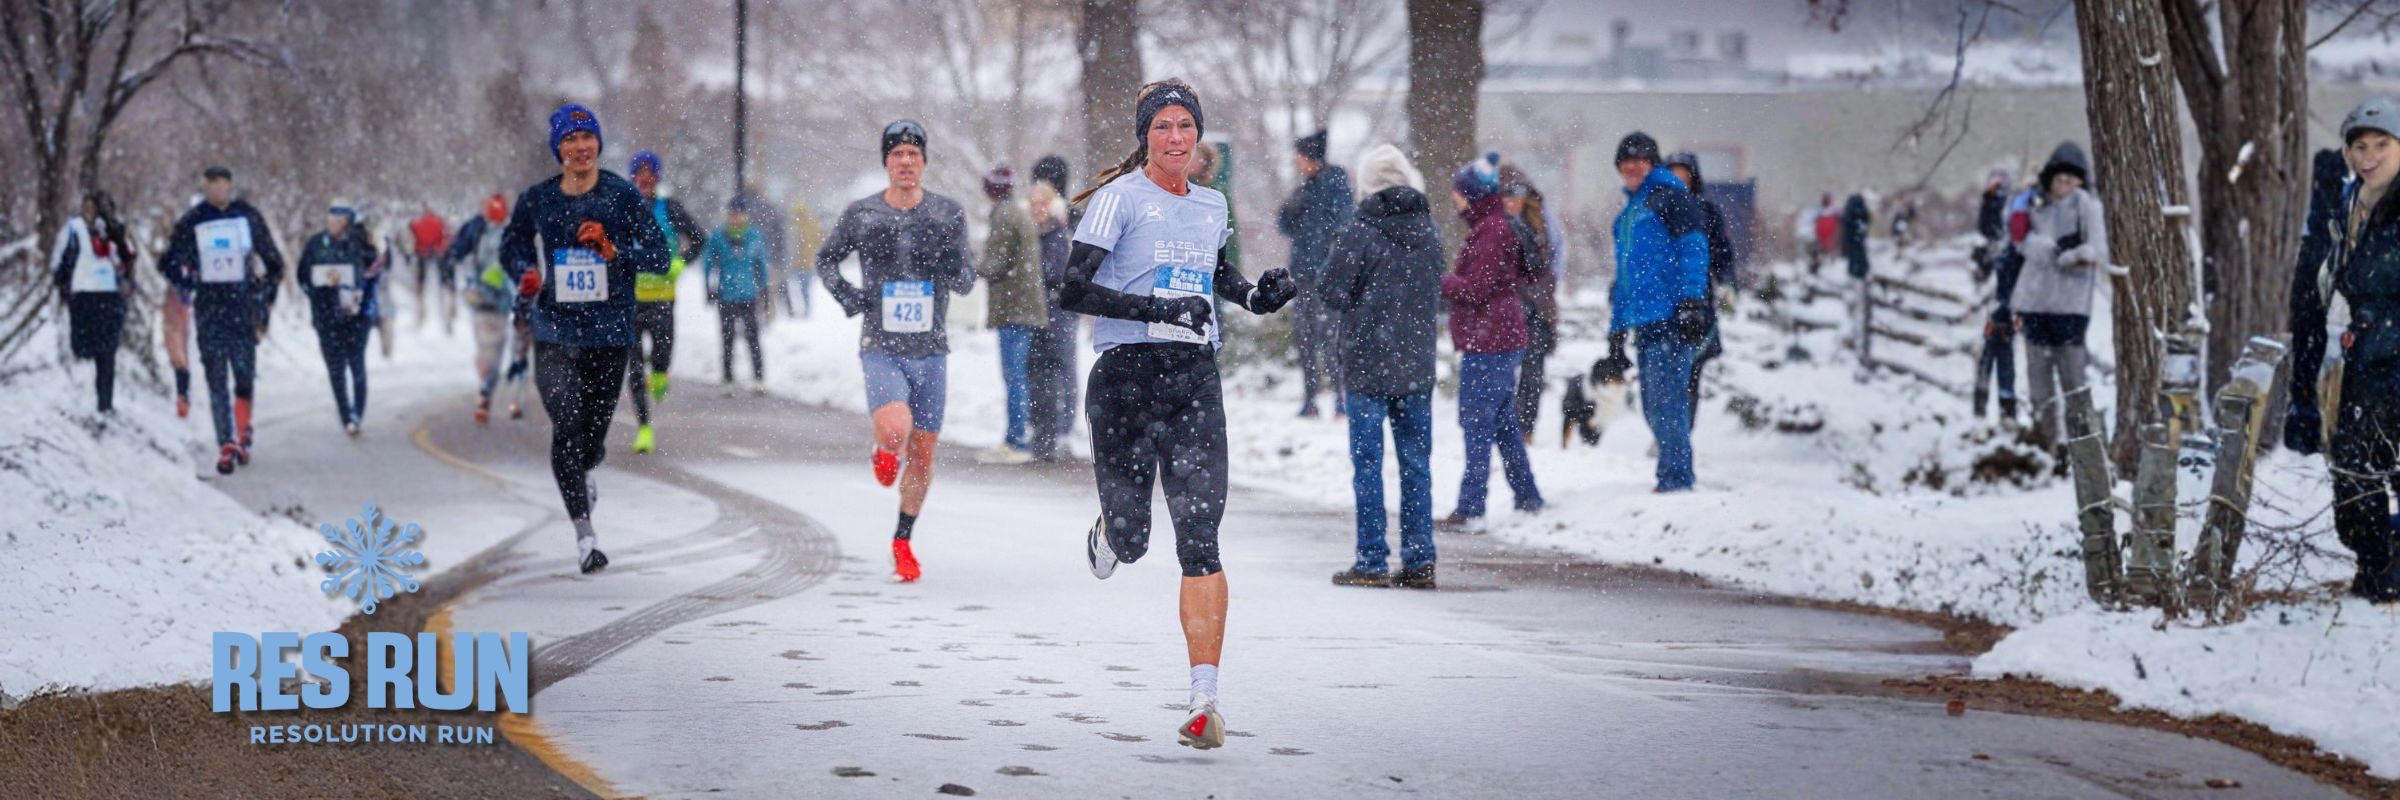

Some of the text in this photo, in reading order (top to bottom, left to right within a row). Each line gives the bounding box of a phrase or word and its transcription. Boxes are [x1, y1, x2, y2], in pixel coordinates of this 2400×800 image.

[1154, 240, 1215, 253] GAZELLE
[1154, 249, 1215, 267] ELITE
[566, 271, 596, 291] 483
[893, 303, 923, 322] 428
